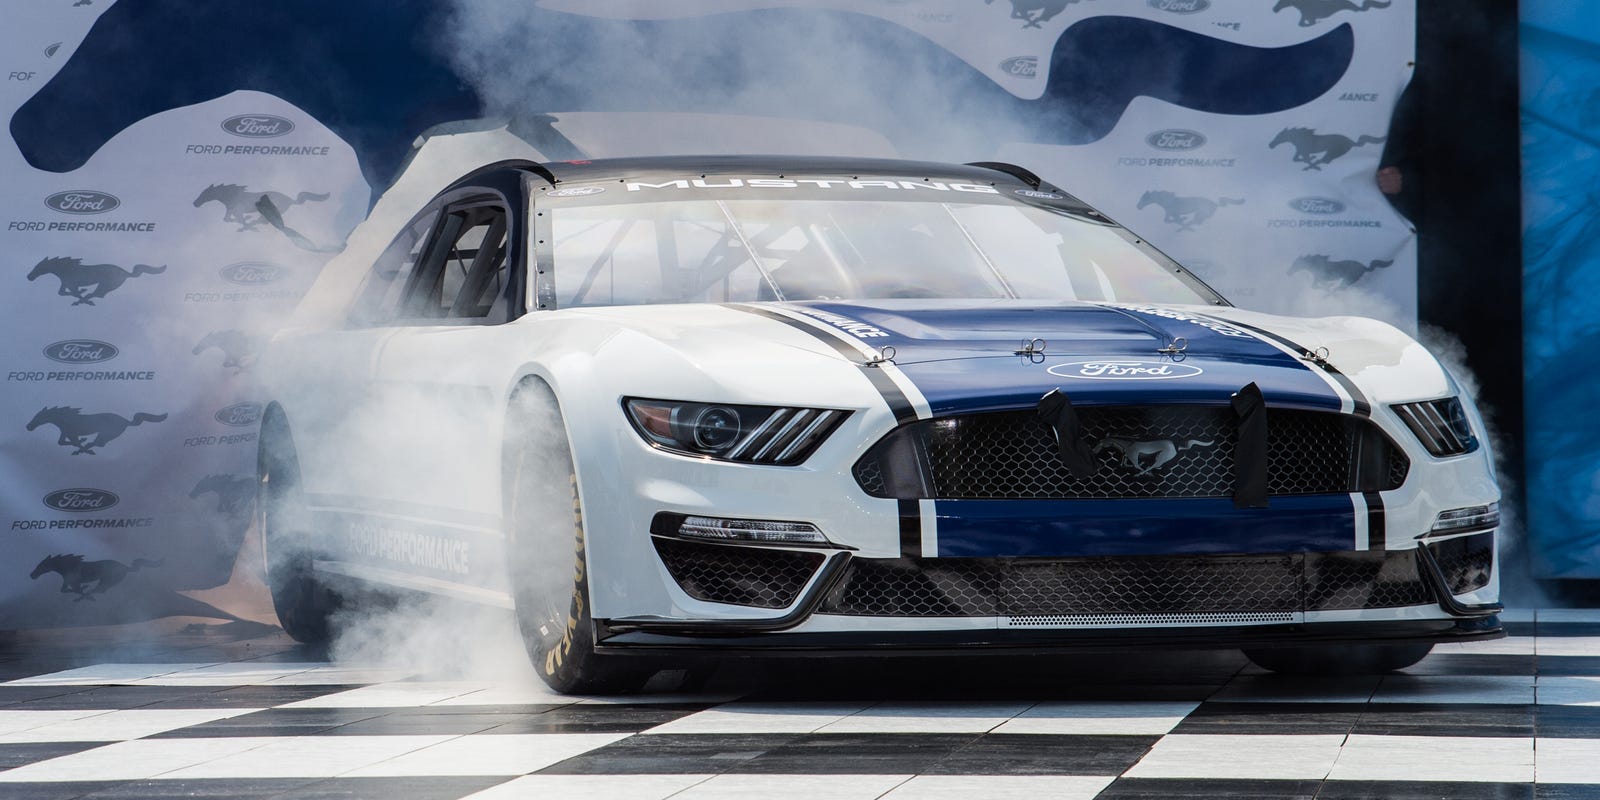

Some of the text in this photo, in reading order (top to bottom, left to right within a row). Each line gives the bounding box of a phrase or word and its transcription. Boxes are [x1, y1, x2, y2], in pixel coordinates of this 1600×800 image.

[185, 144, 330, 156] FORD PERFORMANCE
[1117, 157, 1237, 167] FORD PERFORMANCE
[626, 178, 1001, 195] MUSTANG
[8, 221, 156, 232] FORD PERFORMANCE
[1299, 219, 1382, 228] PERFORMANCE
[1080, 362, 1173, 377] Ford
[7, 371, 156, 381] FORD PERFORMANCE
[183, 436, 217, 447] FORD
[11, 518, 153, 531] FORD PERFORMANCE
[380, 527, 470, 574] PERFORMANCE
